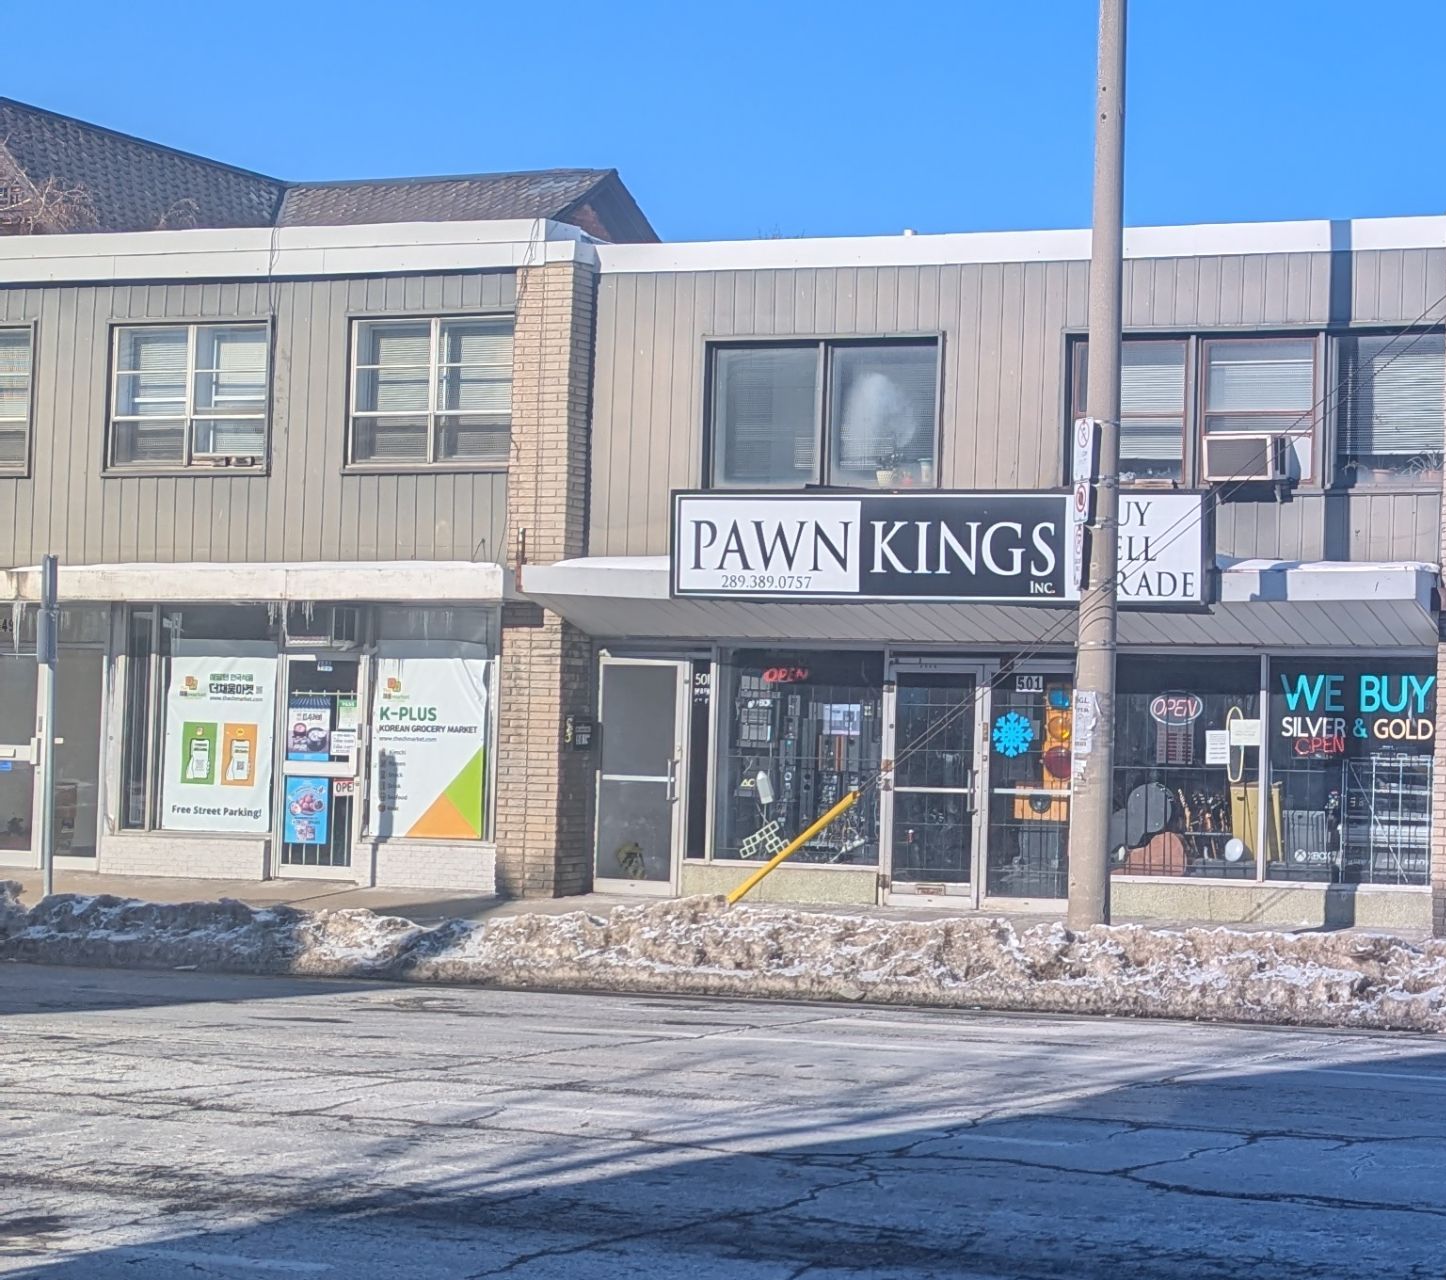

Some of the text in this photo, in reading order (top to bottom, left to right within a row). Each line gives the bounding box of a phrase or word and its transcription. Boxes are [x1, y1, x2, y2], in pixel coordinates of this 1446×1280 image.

[1117, 501, 1152, 527] UY
[690, 519, 1057, 577] PAWN KINGS
[721, 574, 813, 589] 289.389.0757
[1116, 570, 1195, 598] RADE
[763, 667, 809, 683] OPEN
[1017, 676, 1042, 690] 501
[1280, 673, 1436, 714] WE BUY
[379, 706, 437, 721] K-PLUS
[1153, 699, 1197, 717] OPEN
[379, 724, 478, 734] KOREAN GROCERY MARKET
[1281, 716, 1434, 741] SILVER & GOLD
[1294, 736, 1345, 755] OPEN
[335, 782, 354, 793] OPE
[172, 805, 262, 820] Free Street Parking!
